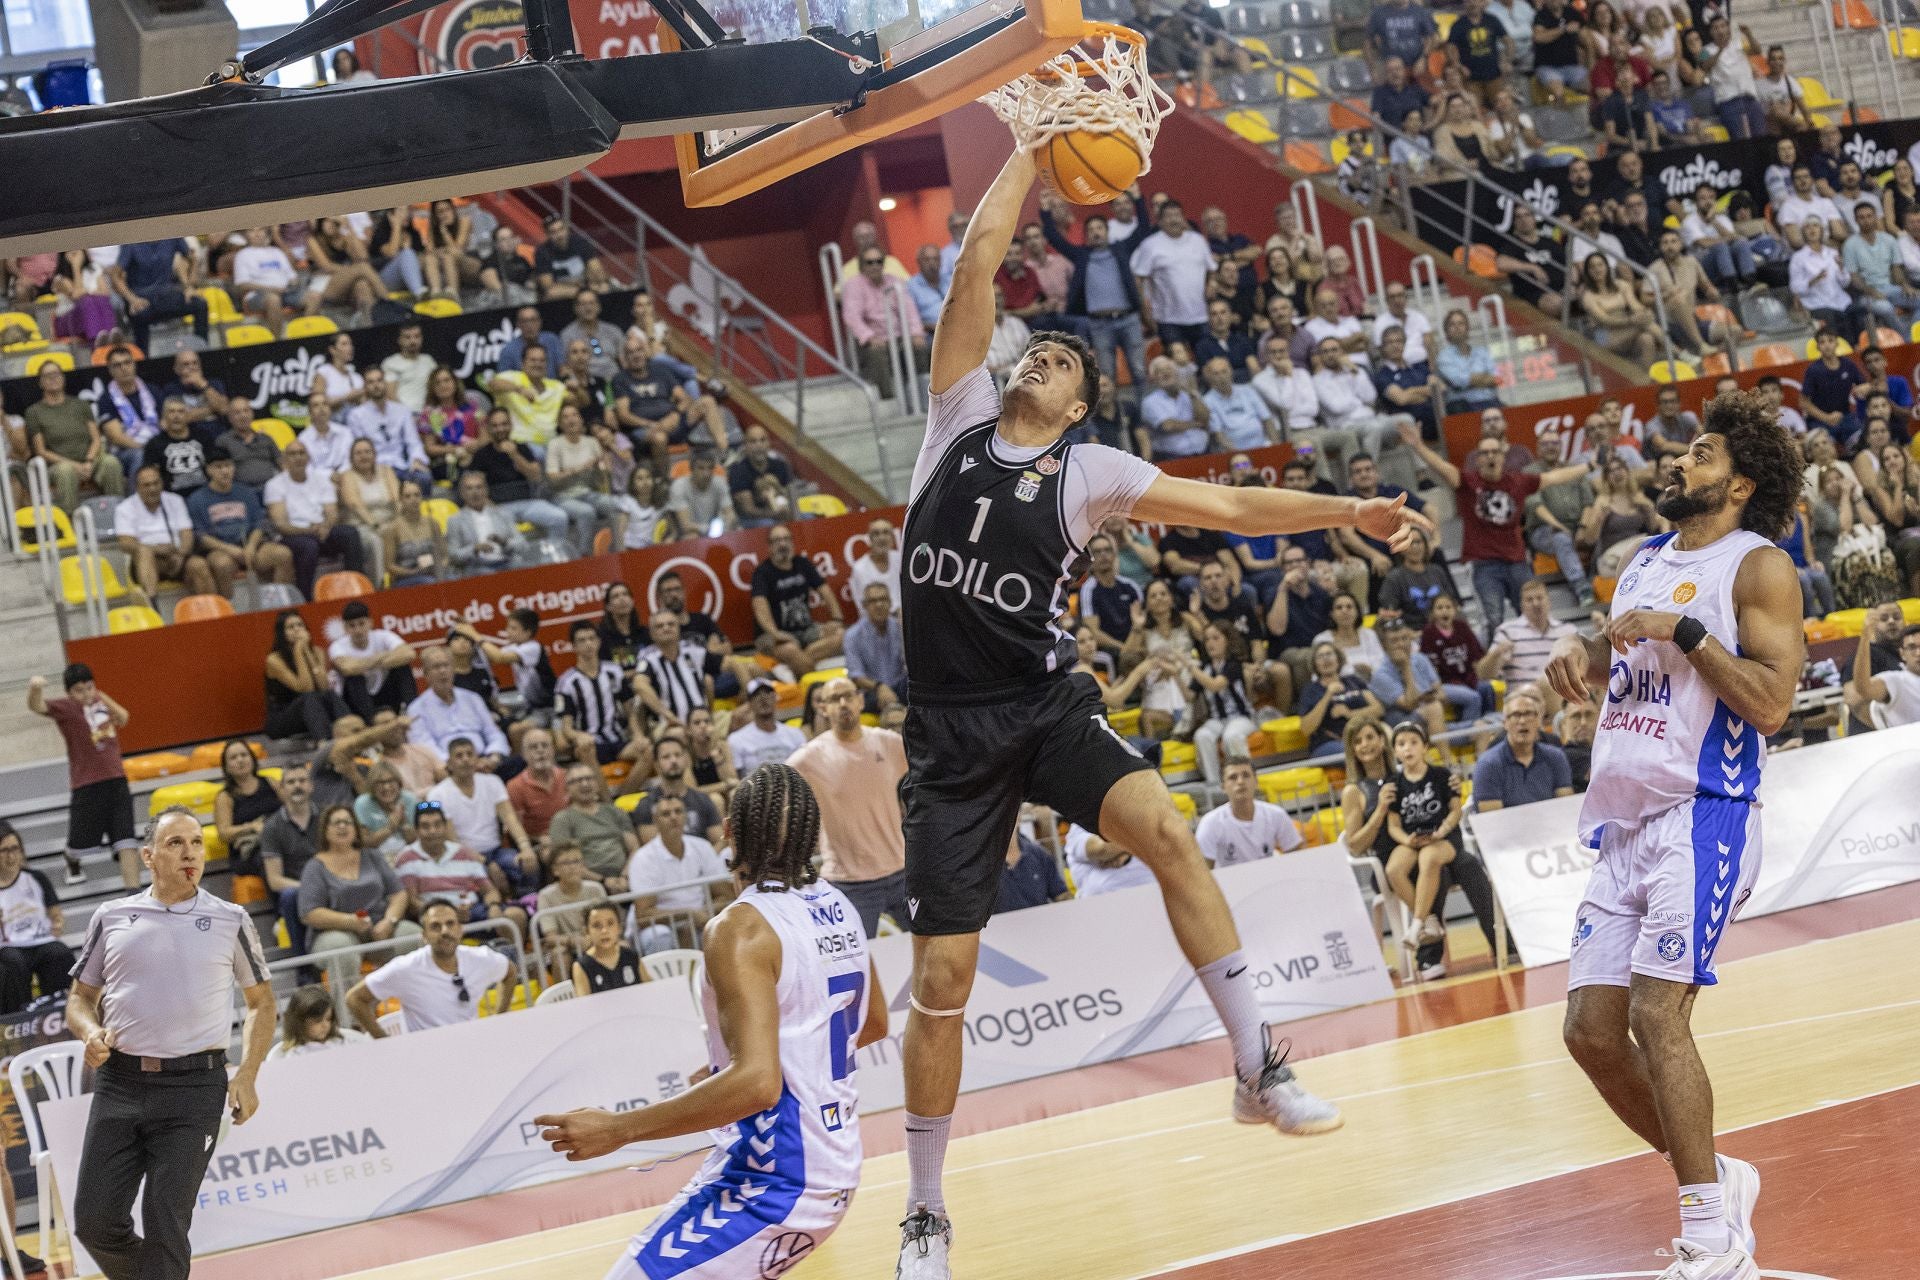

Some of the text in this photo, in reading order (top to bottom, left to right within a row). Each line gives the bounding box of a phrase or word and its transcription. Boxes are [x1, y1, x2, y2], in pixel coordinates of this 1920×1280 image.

[968, 496, 993, 543] 1
[909, 543, 1032, 612] ODILO
[382, 608, 459, 634] Puerto
[464, 600, 494, 624] de
[1637, 670, 1671, 706] HLA
[1599, 712, 1667, 741] ALCANTE
[1840, 831, 1900, 859] Palco
[1273, 955, 1319, 982] VIP
[199, 1157, 394, 1209] FRESH HERBS
